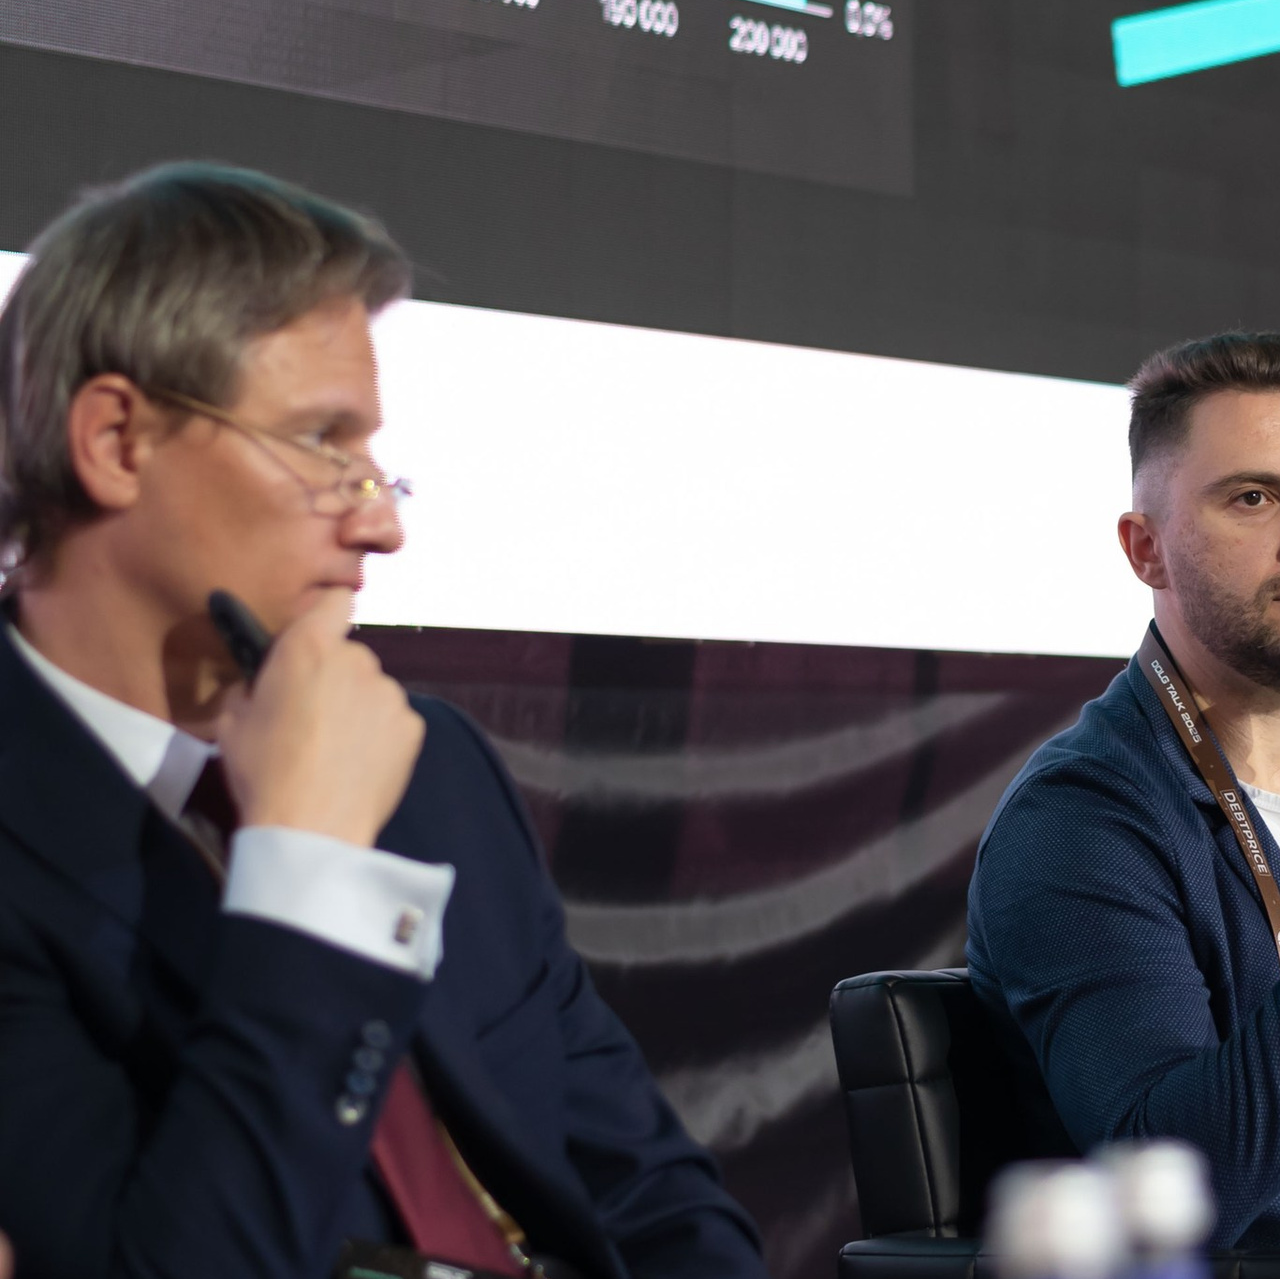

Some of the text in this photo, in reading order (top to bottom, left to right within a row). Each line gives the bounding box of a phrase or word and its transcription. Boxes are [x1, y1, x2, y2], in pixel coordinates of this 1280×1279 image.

[1150, 659, 1202, 744] DOLG TALK 2025
[1223, 792, 1269, 875] DEBTPRICE
